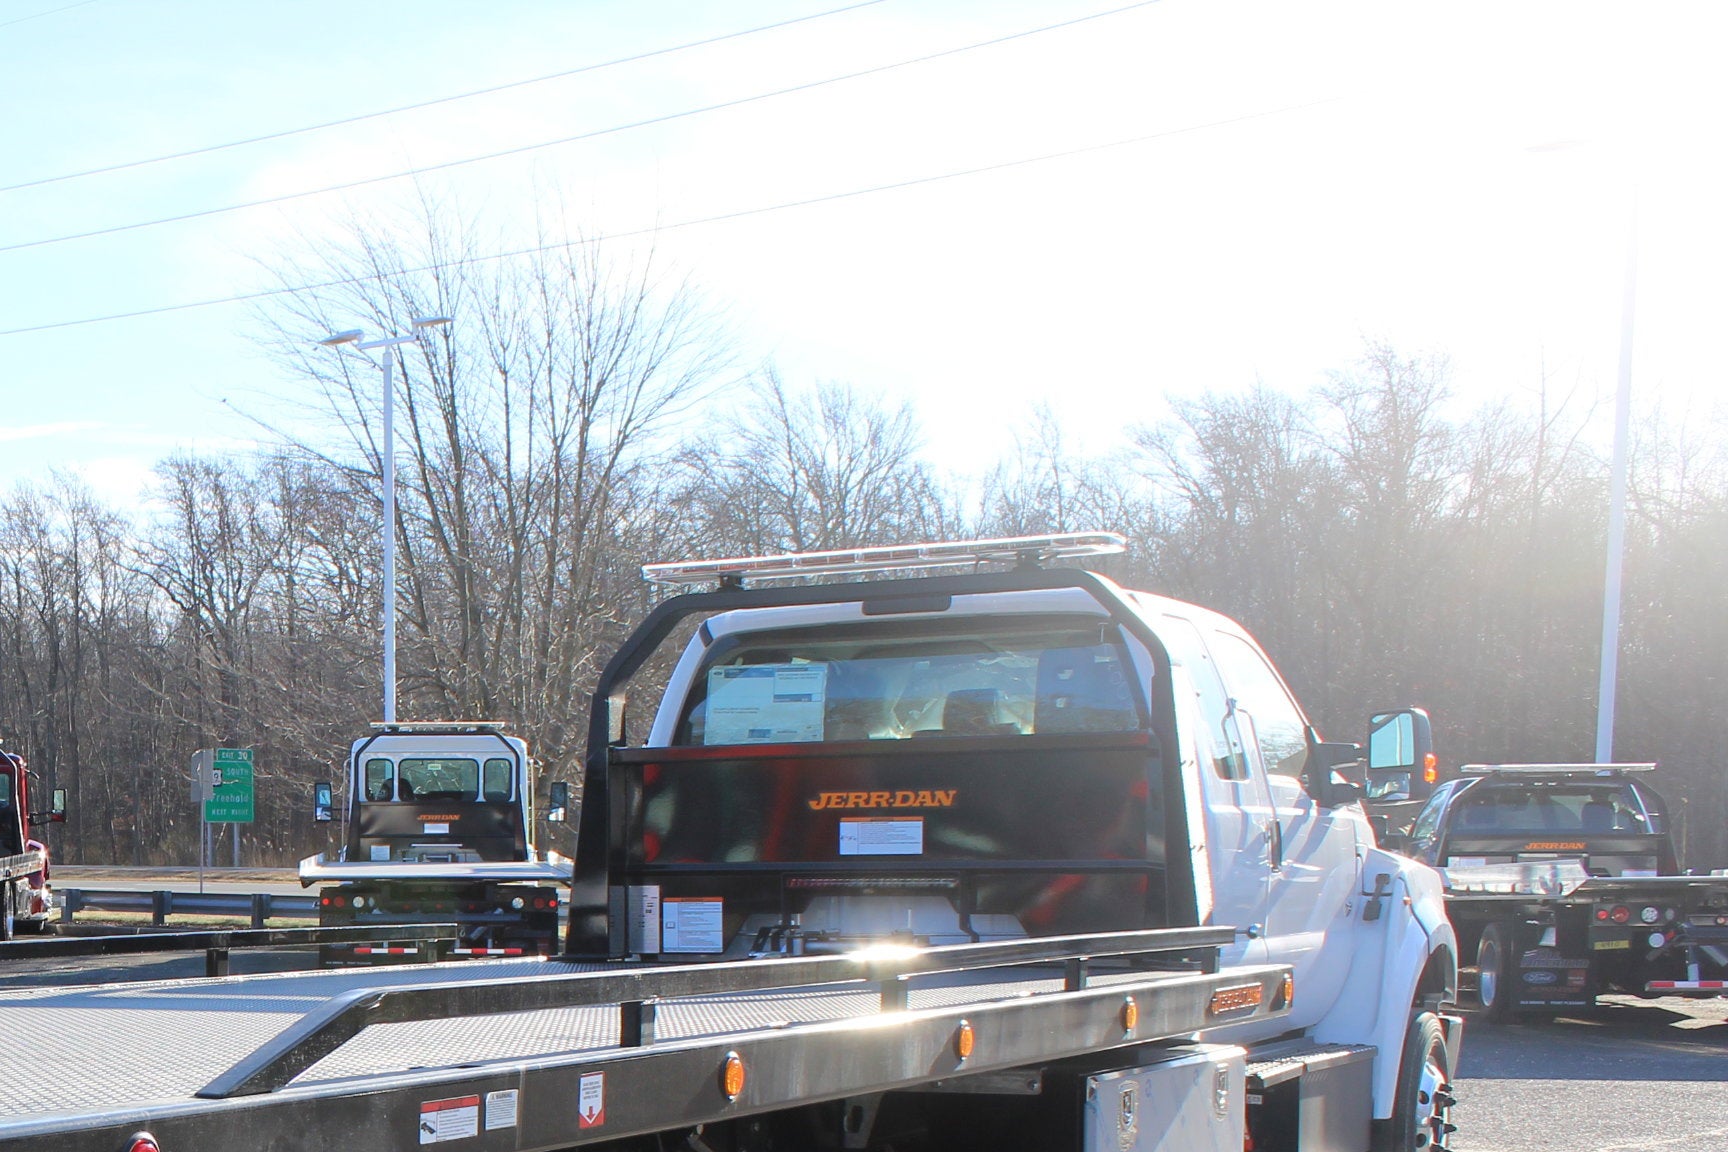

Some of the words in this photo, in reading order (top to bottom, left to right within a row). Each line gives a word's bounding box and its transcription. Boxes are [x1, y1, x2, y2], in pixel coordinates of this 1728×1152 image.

[221, 751, 234, 759] EXIT
[226, 768, 249, 776] SOUTH
[211, 793, 249, 803] reehold
